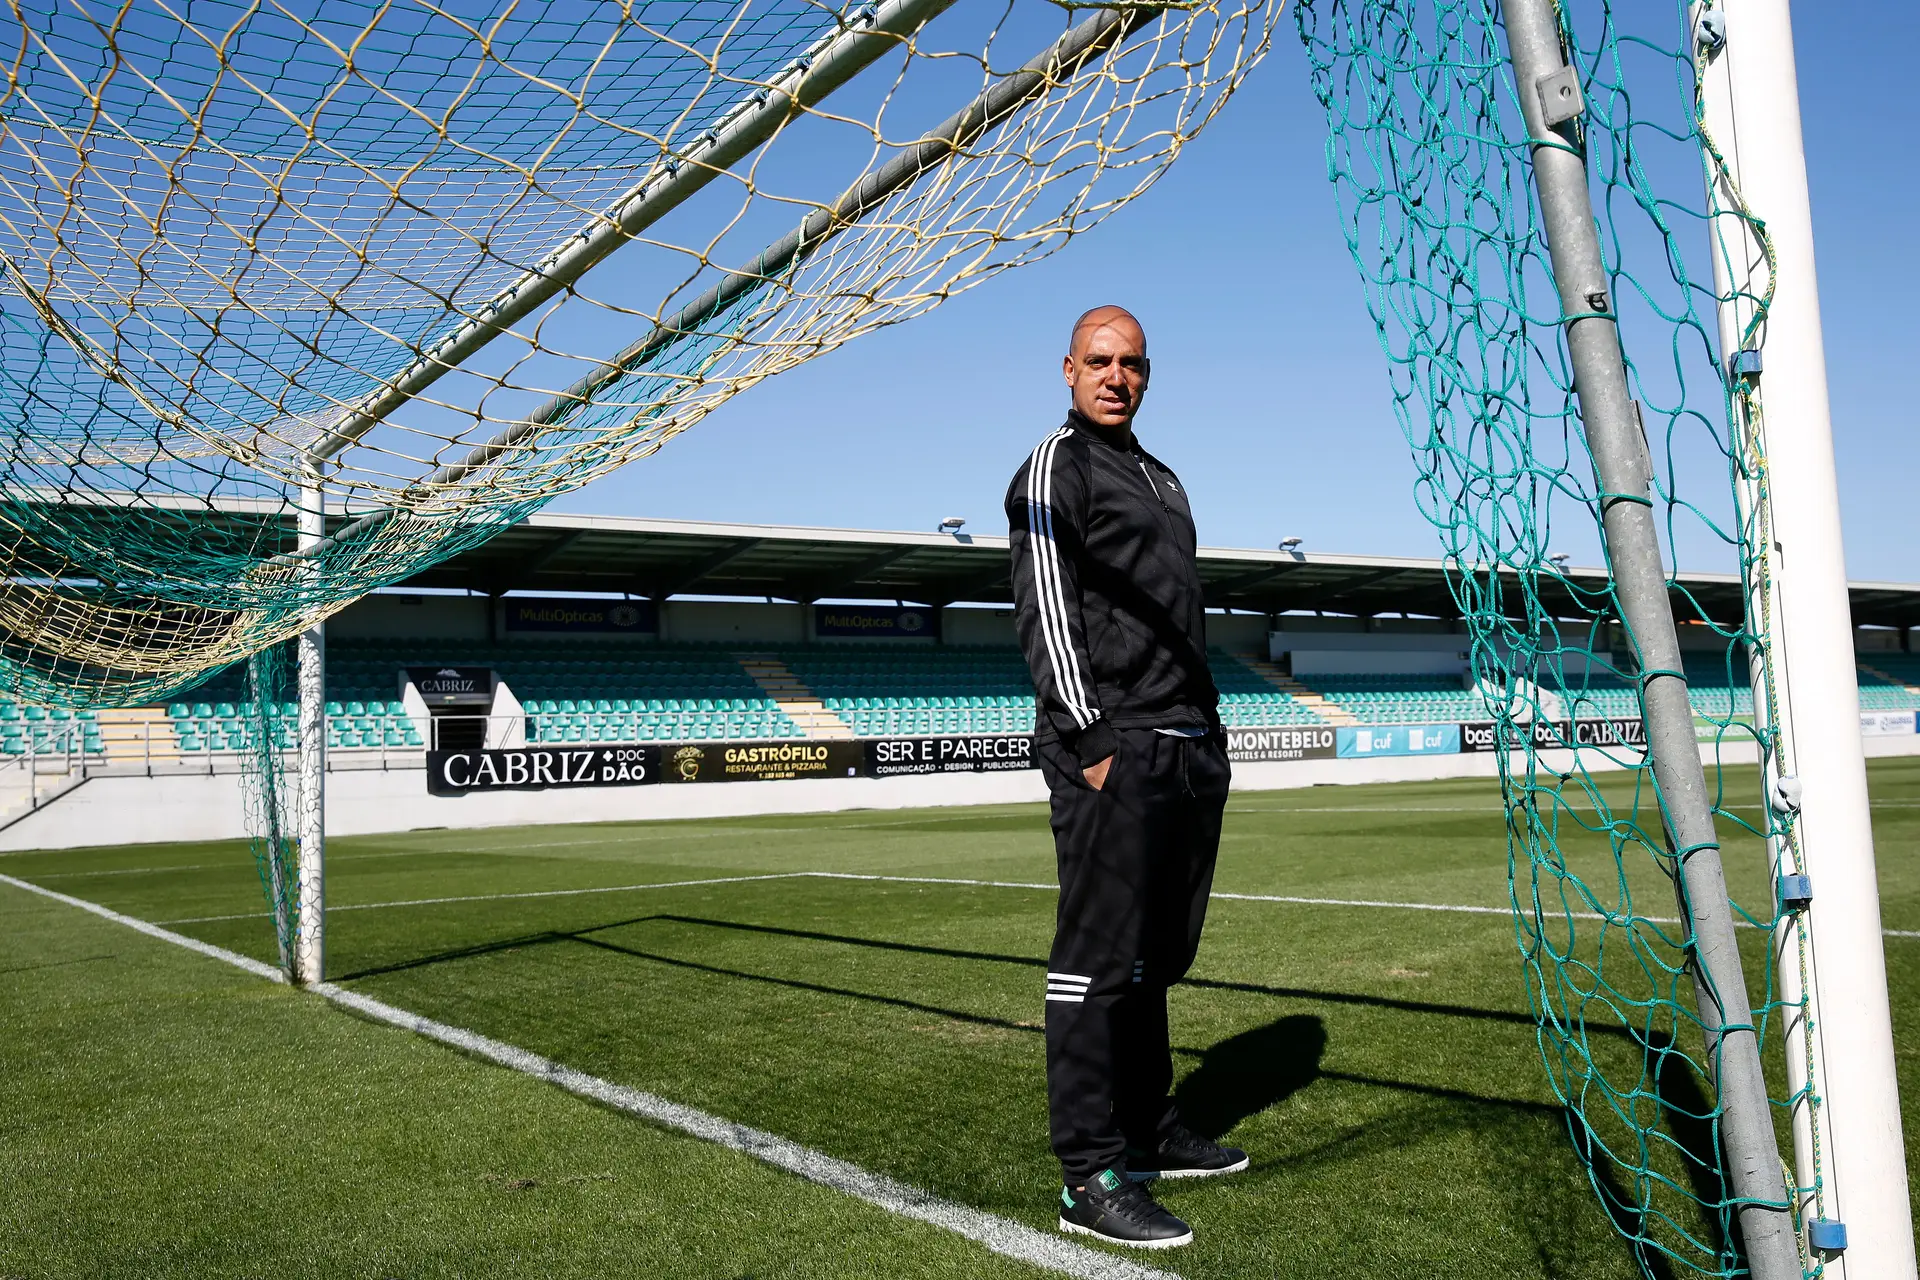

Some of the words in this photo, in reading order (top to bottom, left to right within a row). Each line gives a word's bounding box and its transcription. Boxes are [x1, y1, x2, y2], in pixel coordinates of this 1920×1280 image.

[421, 680, 475, 692] CABRIZ
[1227, 730, 1333, 750] MONTEBELO
[1373, 732, 1392, 749] cuf
[1425, 730, 1443, 748] cuf
[1576, 721, 1641, 744] CABRIZ
[616, 749, 645, 762] DOC
[724, 743, 828, 763] GASTRÓFILO
[876, 741, 914, 761] SER
[921, 740, 934, 760] E
[940, 738, 1031, 759] PARECER
[1228, 751, 1259, 760] HOTELS
[1260, 751, 1266, 759] &
[1268, 750, 1303, 759] RESORTS
[443, 751, 596, 787] CABRIZ
[602, 762, 645, 781] DÃO
[725, 763, 783, 774] RESTAURANTE
[784, 763, 790, 771] &
[791, 762, 827, 771] PIZZARIA
[876, 763, 936, 774] COMUNICAÇÃO
[944, 762, 974, 771] DESIGN
[982, 760, 1031, 769] PUBLICIDADE
